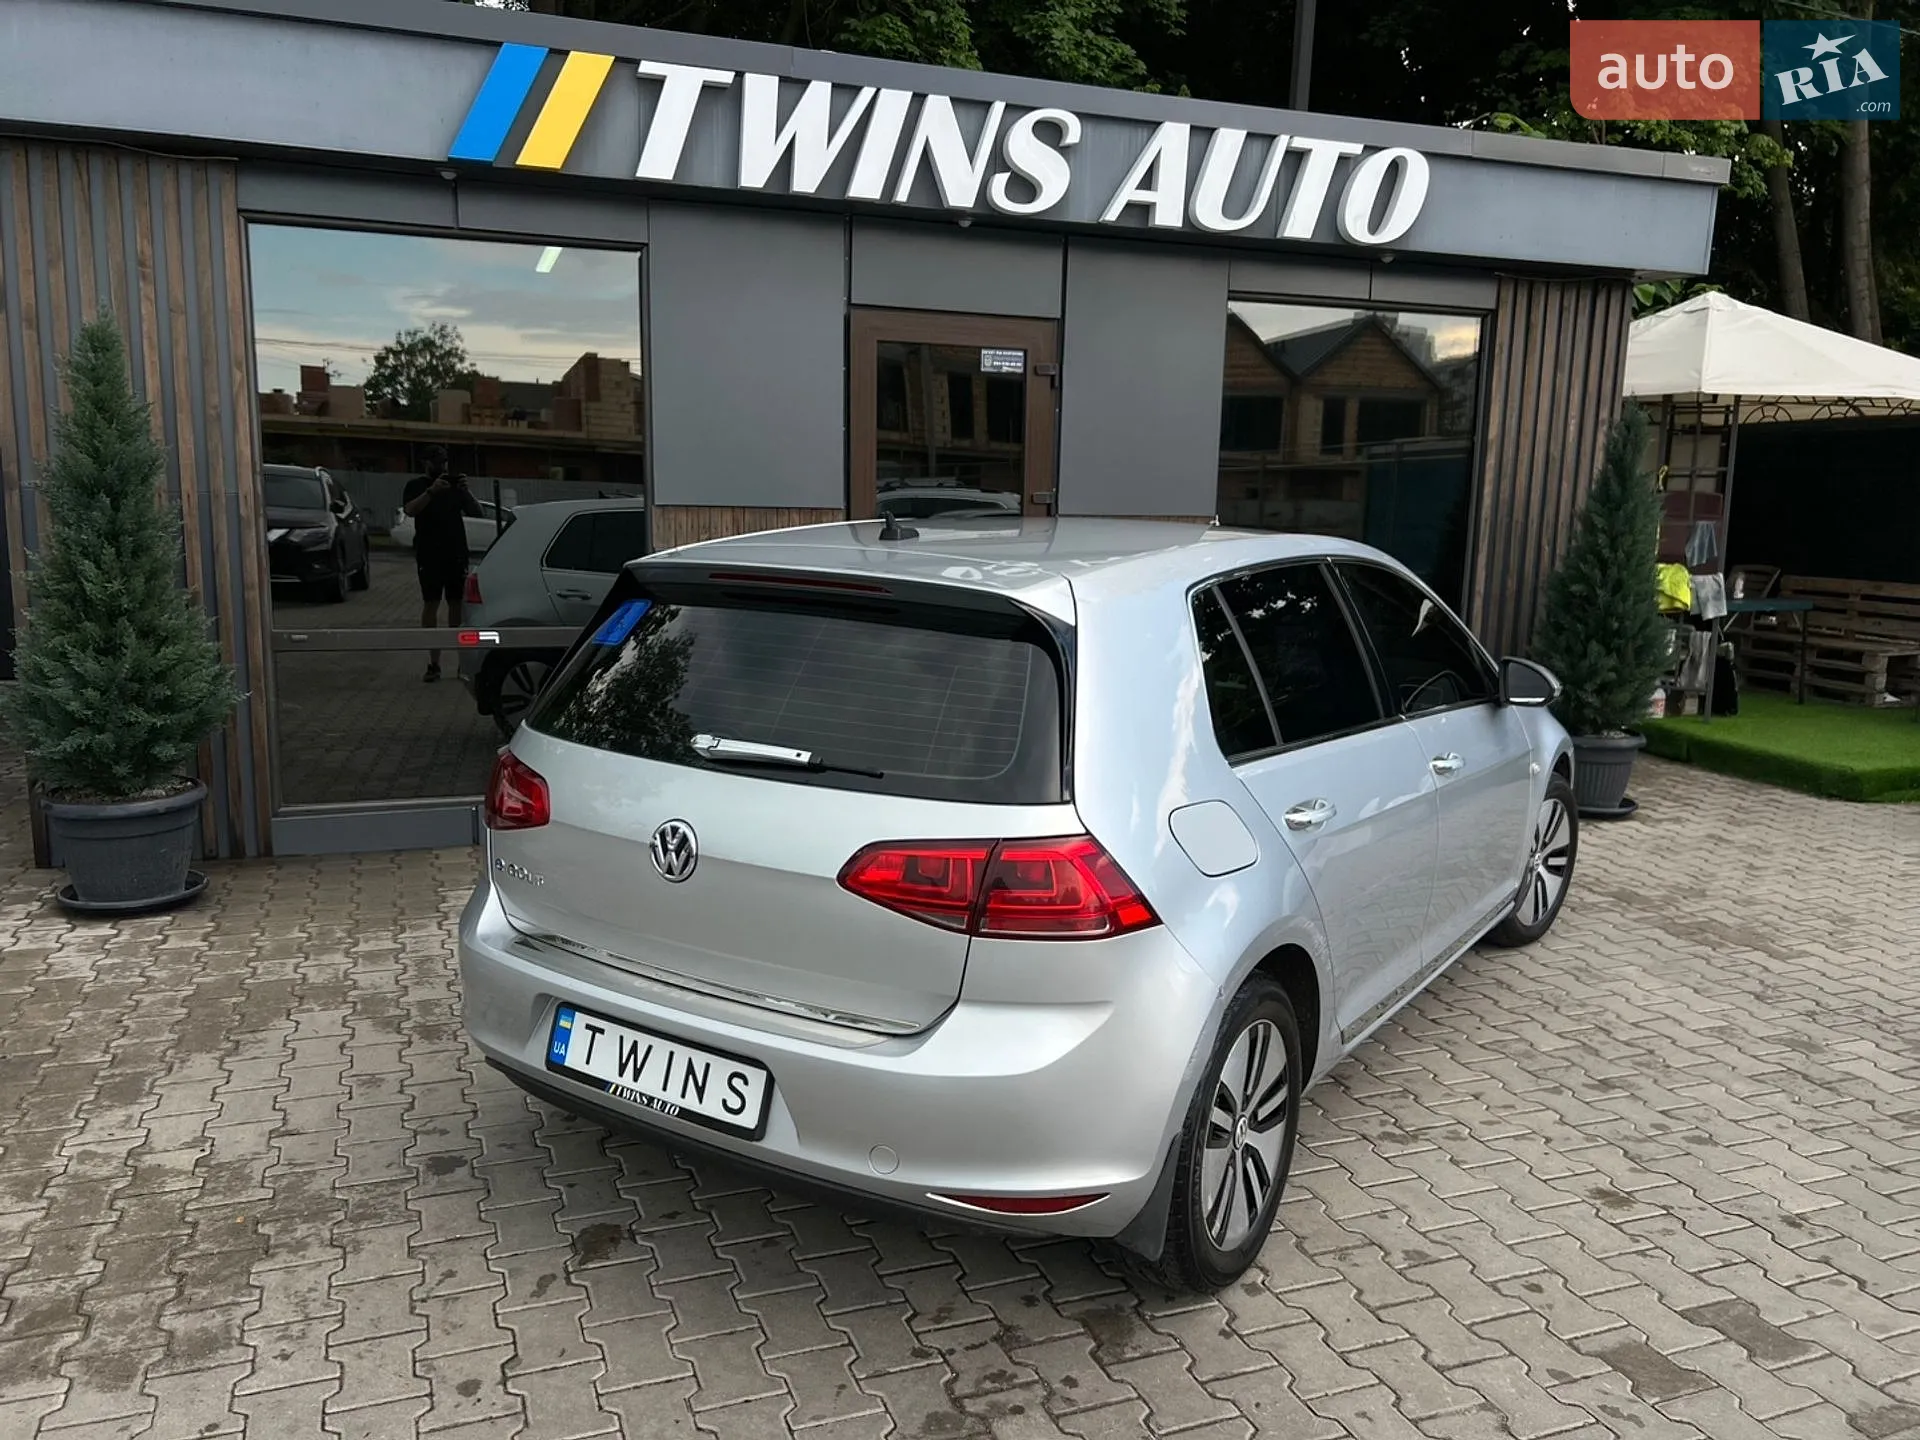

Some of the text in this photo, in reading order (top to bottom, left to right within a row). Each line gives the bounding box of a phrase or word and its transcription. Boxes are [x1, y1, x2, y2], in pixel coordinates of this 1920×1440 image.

[635, 59, 1430, 246] TWINS AUTO
[552, 1041, 566, 1057] UA
[614, 1086, 681, 1117] TWINS AUTO
